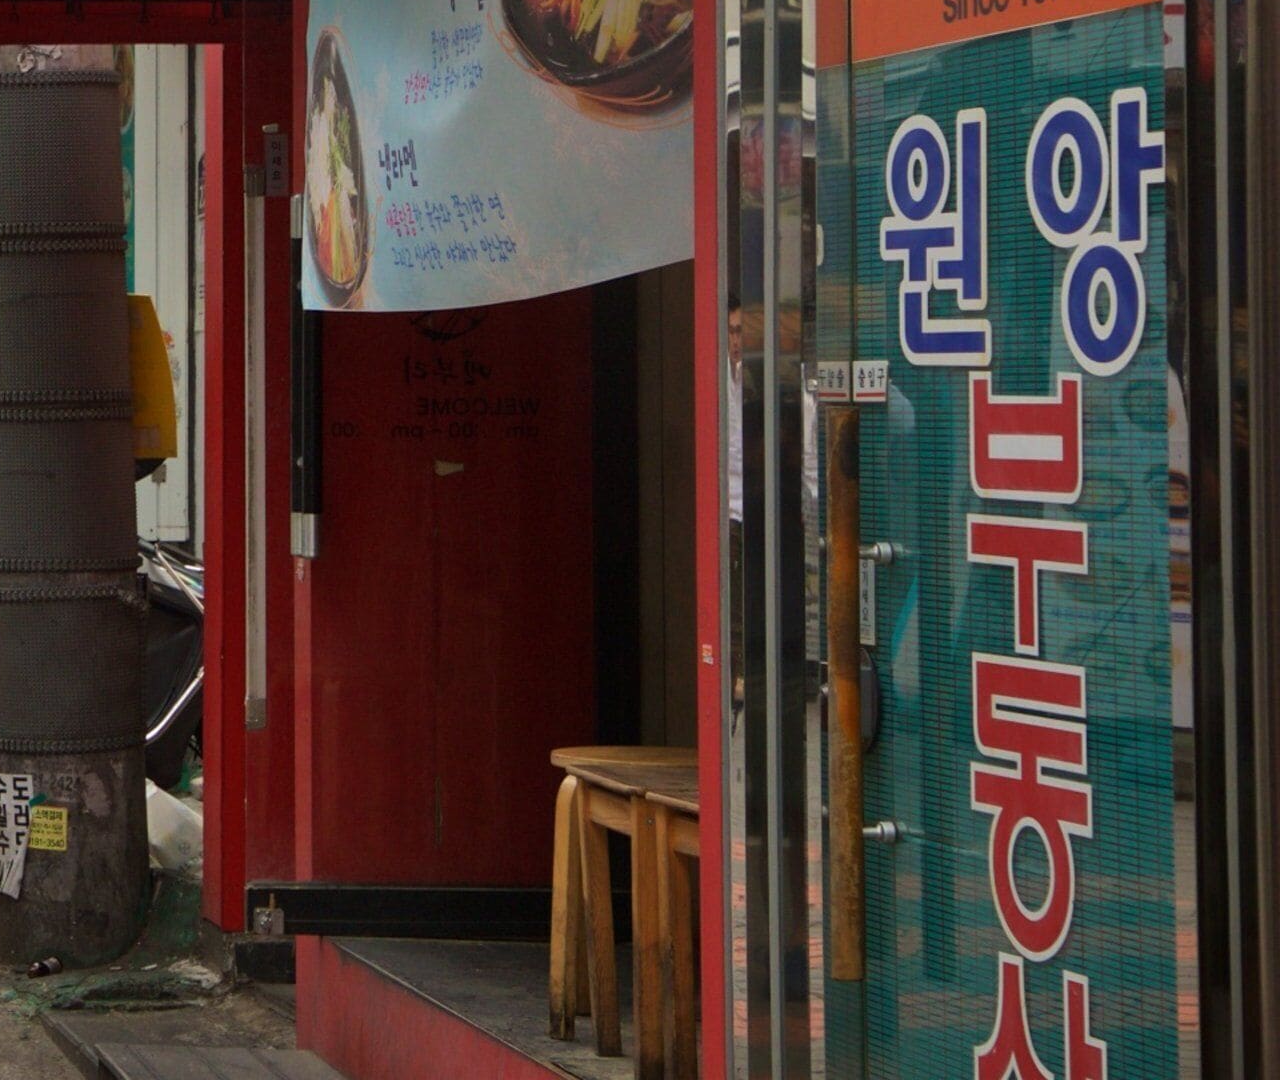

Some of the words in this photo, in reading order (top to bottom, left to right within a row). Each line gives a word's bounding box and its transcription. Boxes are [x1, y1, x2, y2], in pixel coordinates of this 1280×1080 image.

[378, 136, 419, 189] 냉라멘
[880, 87, 1165, 378] 원앙
[857, 367, 886, 389] 출입구
